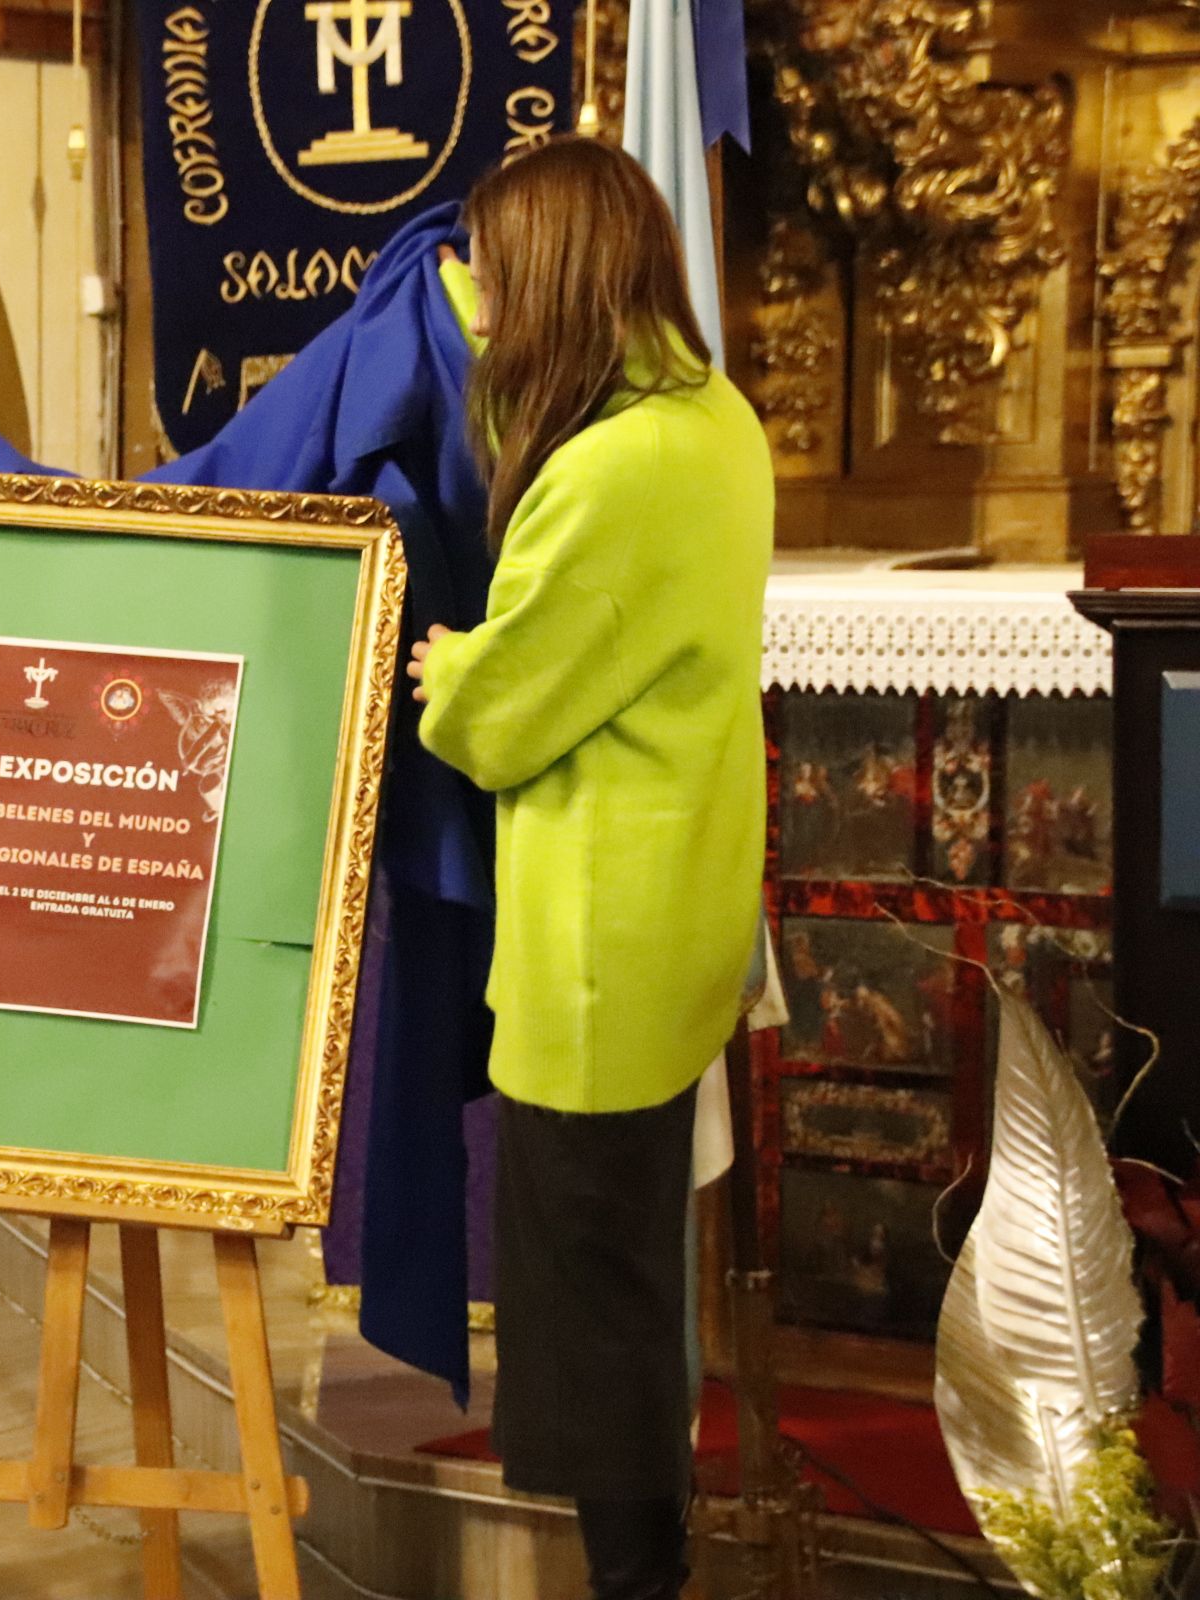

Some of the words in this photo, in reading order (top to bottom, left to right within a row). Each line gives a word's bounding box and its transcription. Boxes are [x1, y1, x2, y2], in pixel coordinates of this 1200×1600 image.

[79, 810, 114, 827] DEL
[119, 813, 191, 835] MUNDO
[82, 832, 95, 848] Y
[98, 857, 122, 873] DE
[127, 858, 204, 881] ESPAÑA
[12, 887, 19, 897] 2
[21, 887, 35, 898] DE
[36, 888, 96, 904] DICIEMBRE
[97, 895, 111, 905] AL
[112, 896, 120, 906] 6
[122, 896, 137, 908] DE
[138, 897, 175, 912] ENERO
[30, 900, 80, 915] ENTRADA
[81, 905, 134, 920] GRATUITA
